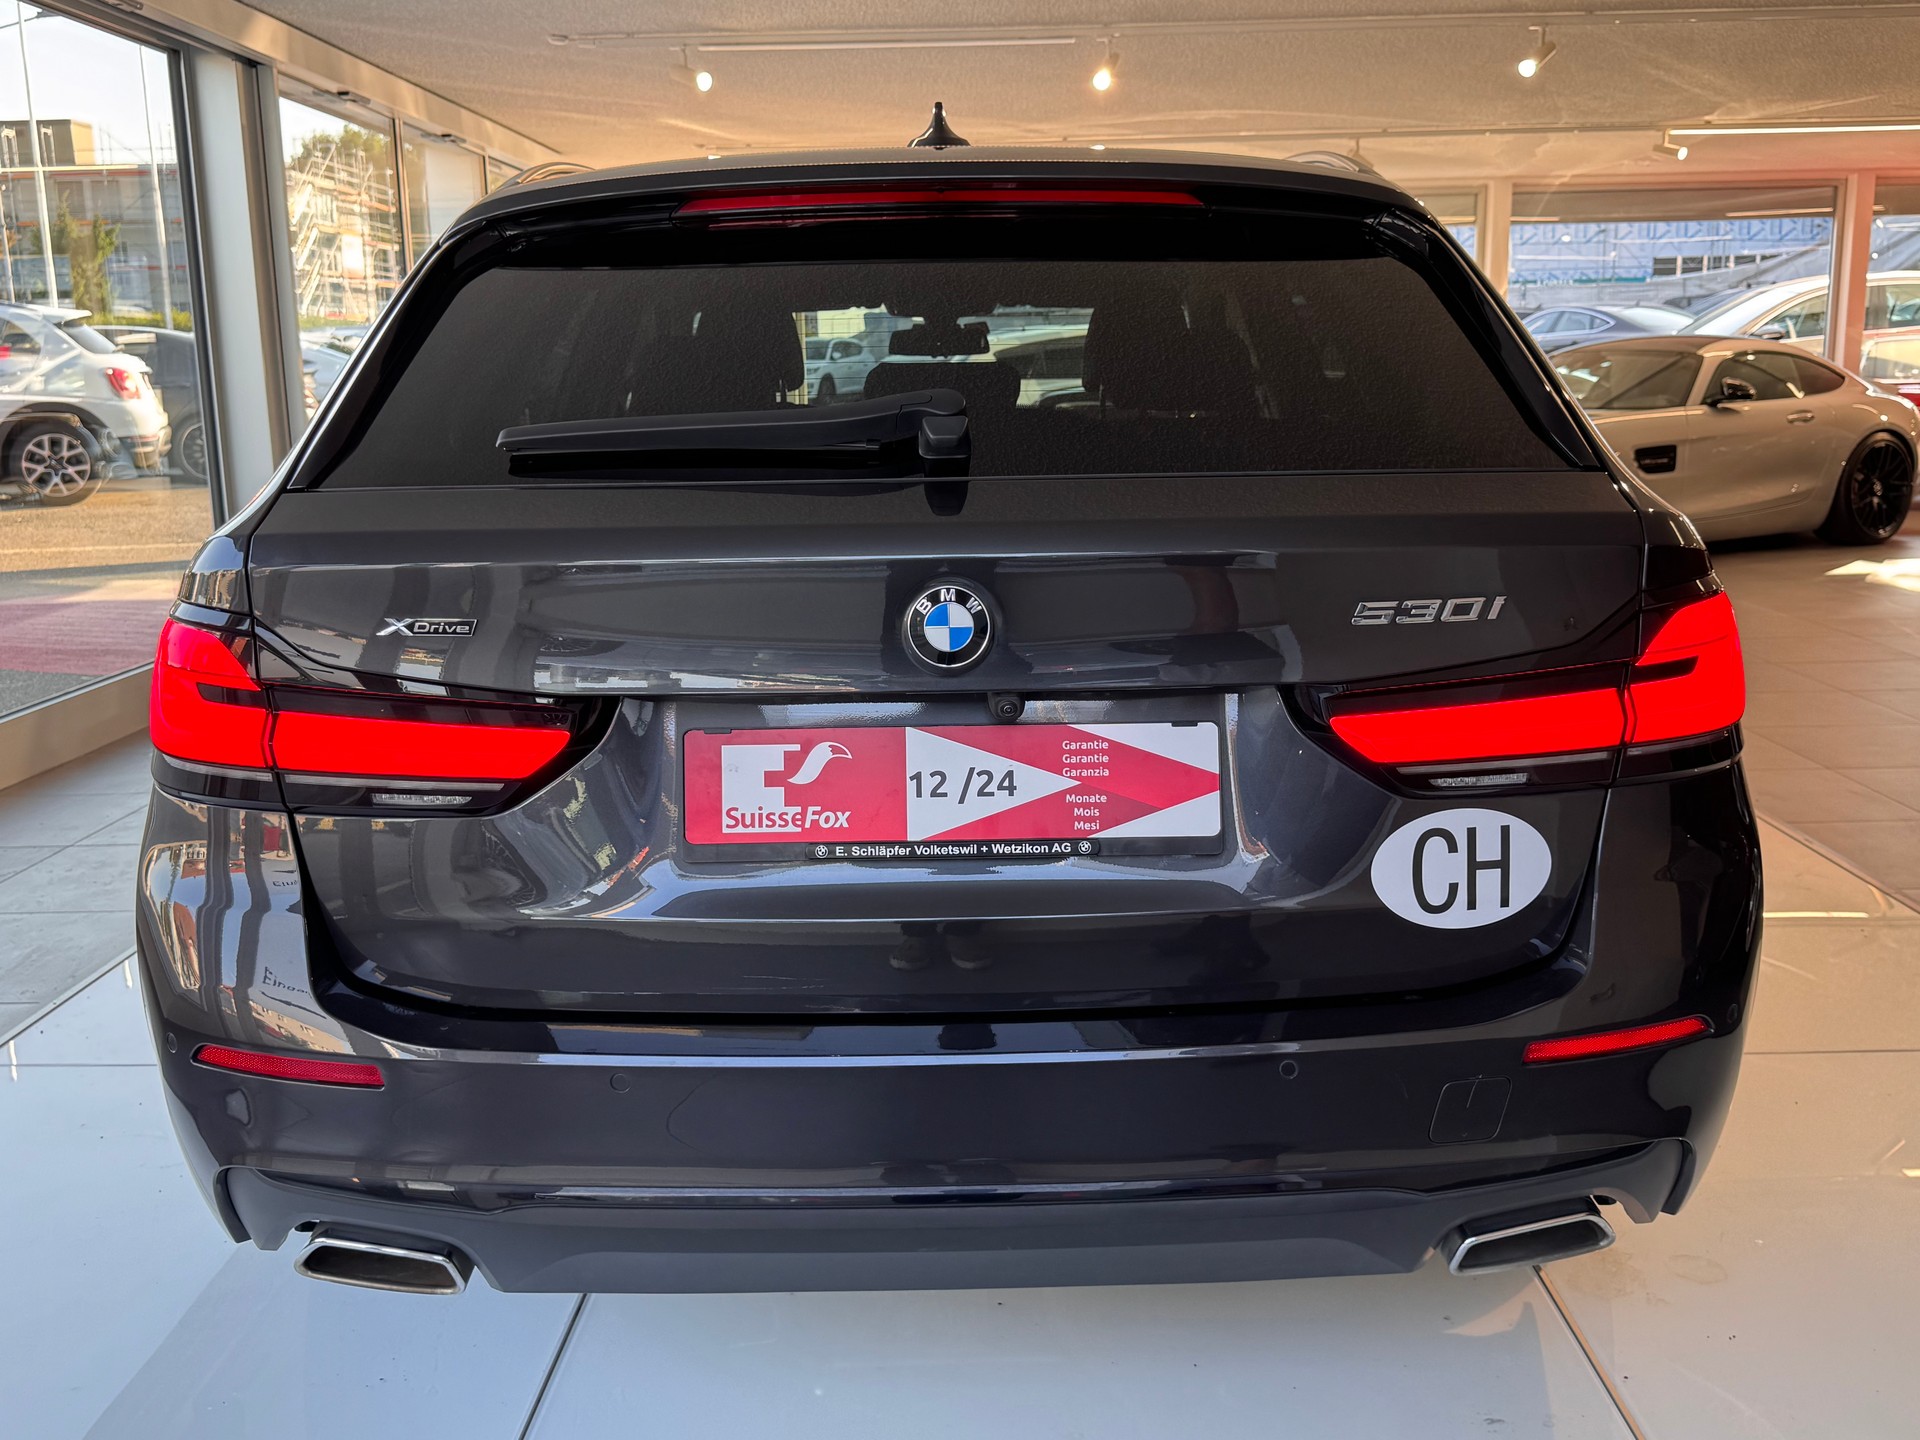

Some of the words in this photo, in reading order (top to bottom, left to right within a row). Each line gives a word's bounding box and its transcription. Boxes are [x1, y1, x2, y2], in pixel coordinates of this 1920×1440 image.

[915, 588, 983, 616] BMW
[1350, 595, 1507, 626] 530i
[1062, 739, 1109, 750] Garantie
[1062, 752, 1110, 763] Garantie
[1062, 766, 1110, 777] Garanzia
[908, 770, 949, 798] 12
[1065, 793, 1108, 803] Monate
[1073, 806, 1100, 817] Mois
[1073, 820, 1100, 831] Mesi
[835, 846, 849, 857] E.
[851, 845, 912, 858] Schläpfer
[914, 843, 978, 856] Volketswil
[980, 844, 989, 854] +
[991, 842, 1050, 855] Wetzikon
[1051, 842, 1072, 854] AG
[1412, 824, 1511, 915] CH
